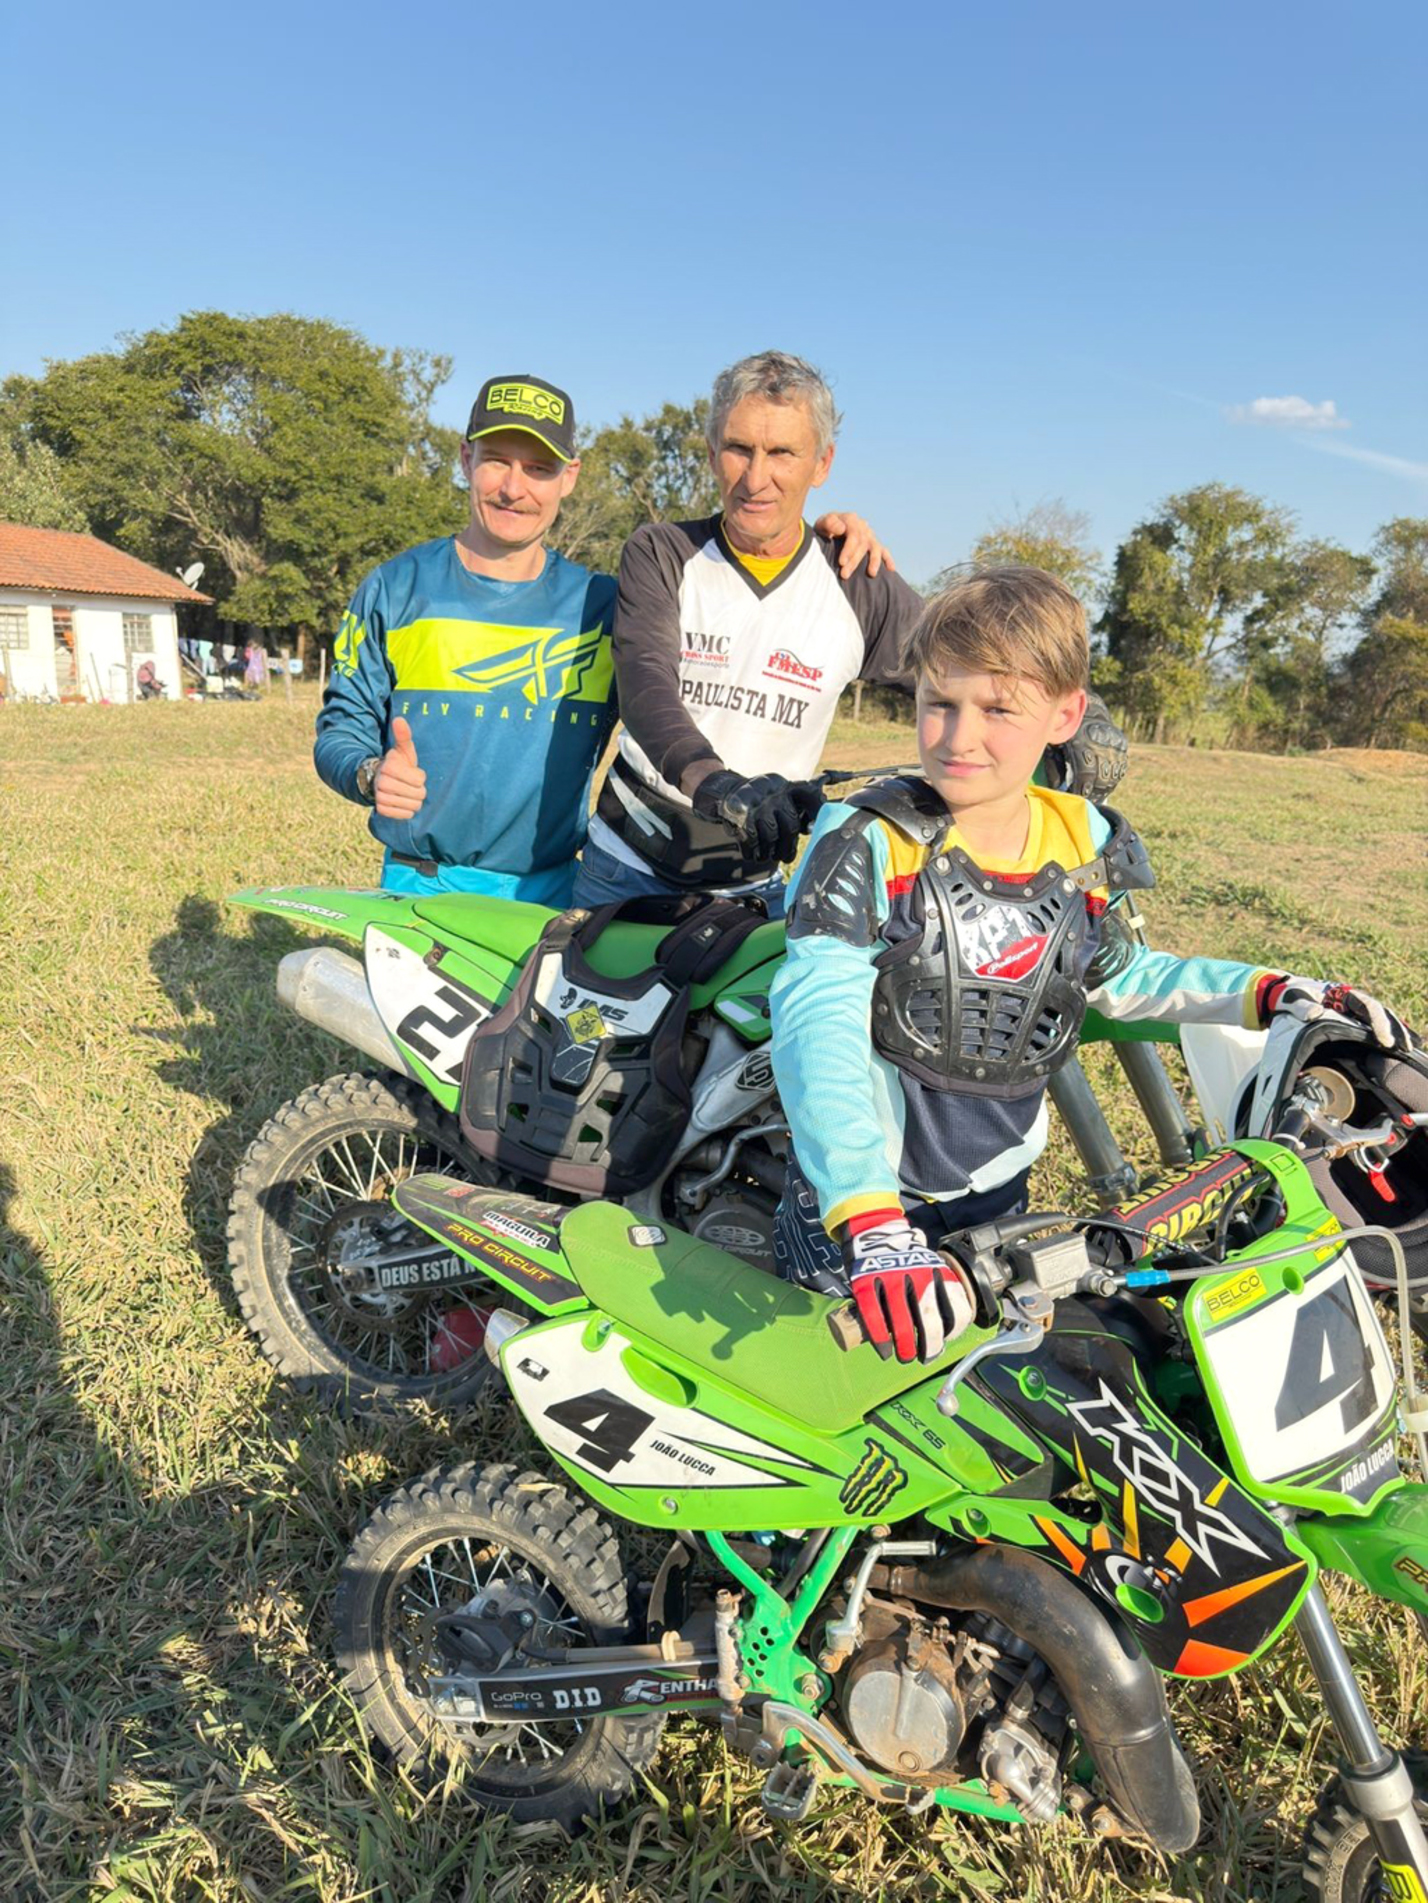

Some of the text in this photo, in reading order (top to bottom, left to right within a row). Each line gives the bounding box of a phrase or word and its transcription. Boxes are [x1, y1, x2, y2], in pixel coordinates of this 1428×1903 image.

[490, 388, 562, 416] BELCO
[685, 631, 731, 655] VMC
[402, 702, 598, 727] FLY RACING
[681, 679, 768, 718] PAULISTA
[771, 693, 810, 729] MX
[396, 985, 484, 1084] 2
[485, 1211, 550, 1246] MAGUILA
[381, 1264, 419, 1288] DEUS
[422, 1254, 461, 1282] ESTÁ
[446, 1223, 484, 1246] PRO
[482, 1243, 554, 1283] CIRCUIT
[860, 1252, 945, 1273] ASTAR
[1206, 1275, 1260, 1311] BELCO
[1274, 1275, 1379, 1435] 4
[543, 1388, 656, 1473] 4
[650, 1439, 716, 1477] JOÃO LUCCA
[1340, 1439, 1394, 1494] JOÃO LUCCA
[490, 1691, 542, 1701] GoPro
